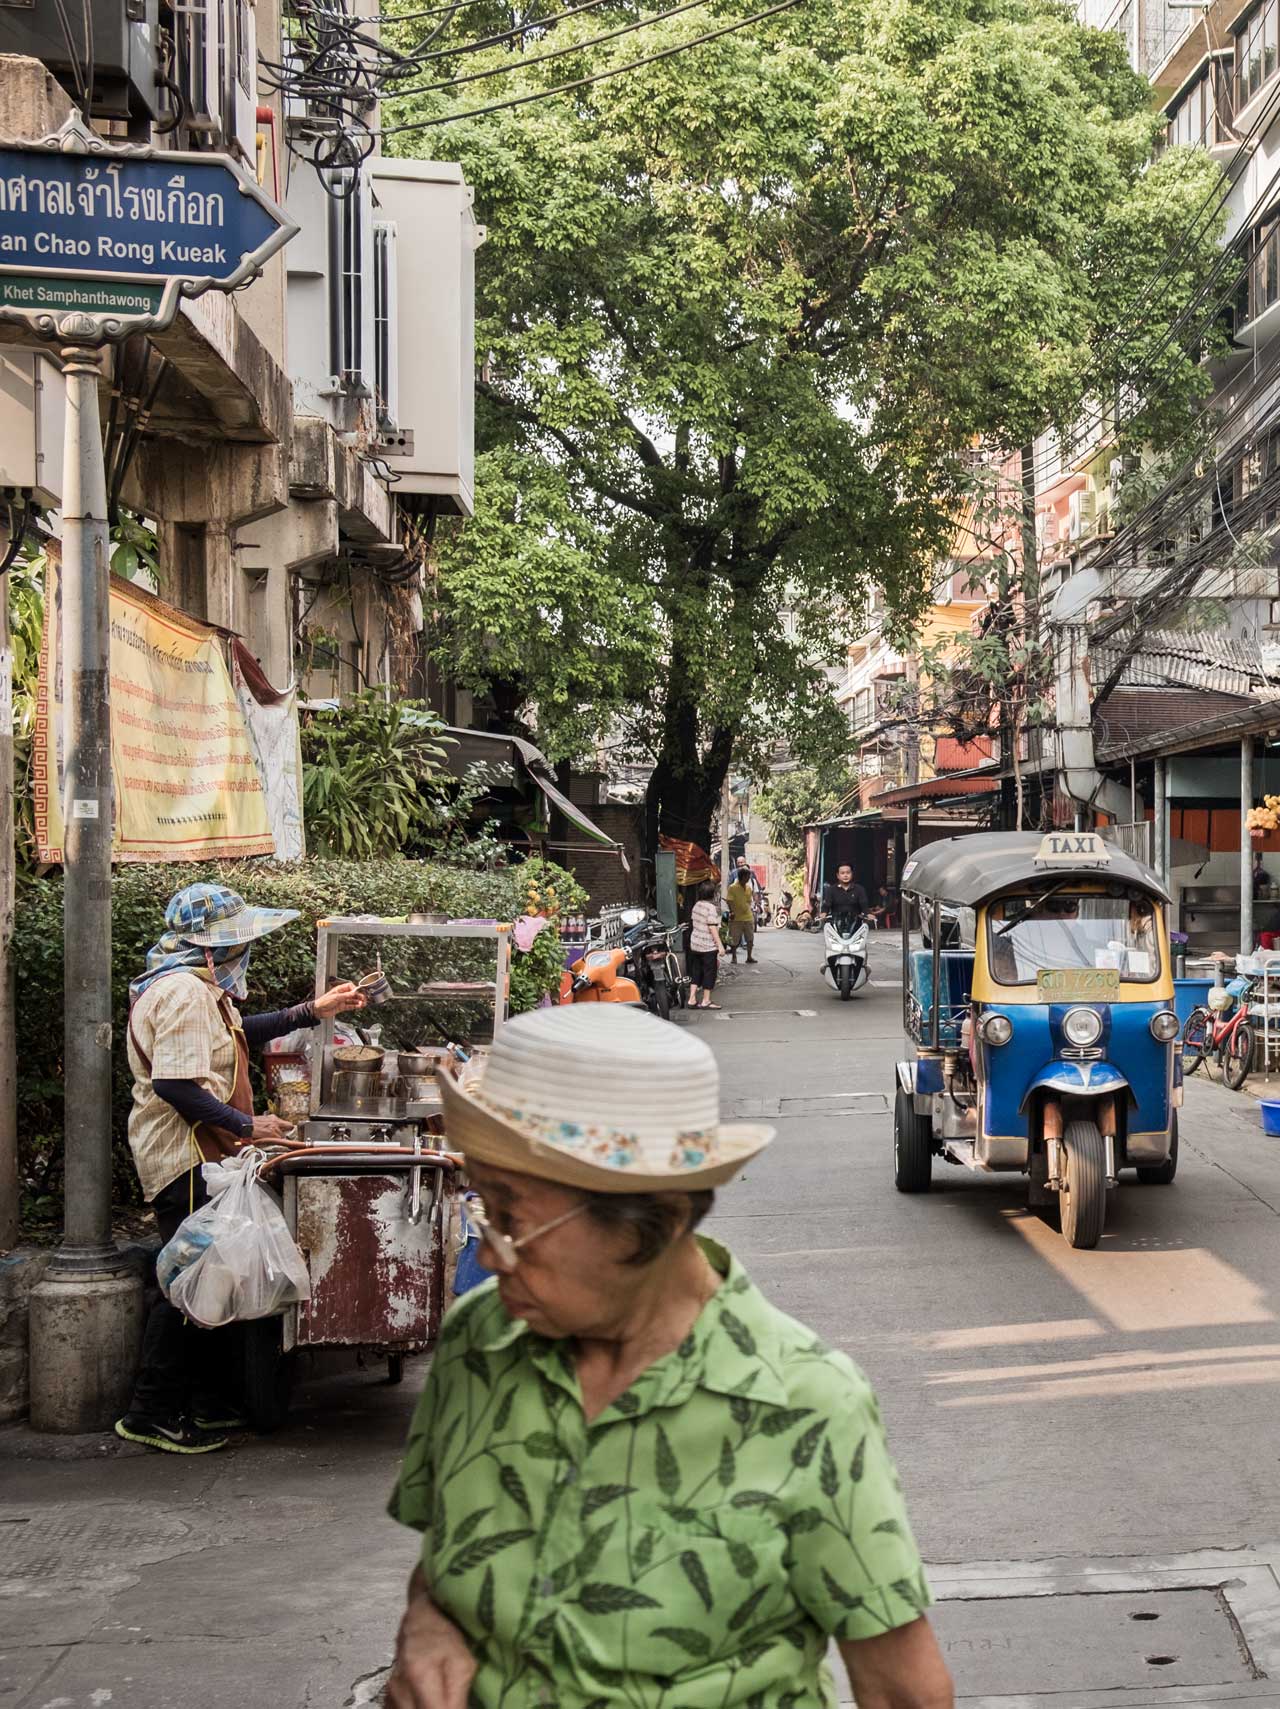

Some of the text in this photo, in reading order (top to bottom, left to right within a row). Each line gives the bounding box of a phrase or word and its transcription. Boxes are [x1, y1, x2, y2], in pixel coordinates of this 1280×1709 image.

[0, 232, 227, 265] an Chao Rong Kueak
[3, 284, 151, 310] Khet Samphanthawong
[1048, 837, 1097, 854] TAXI
